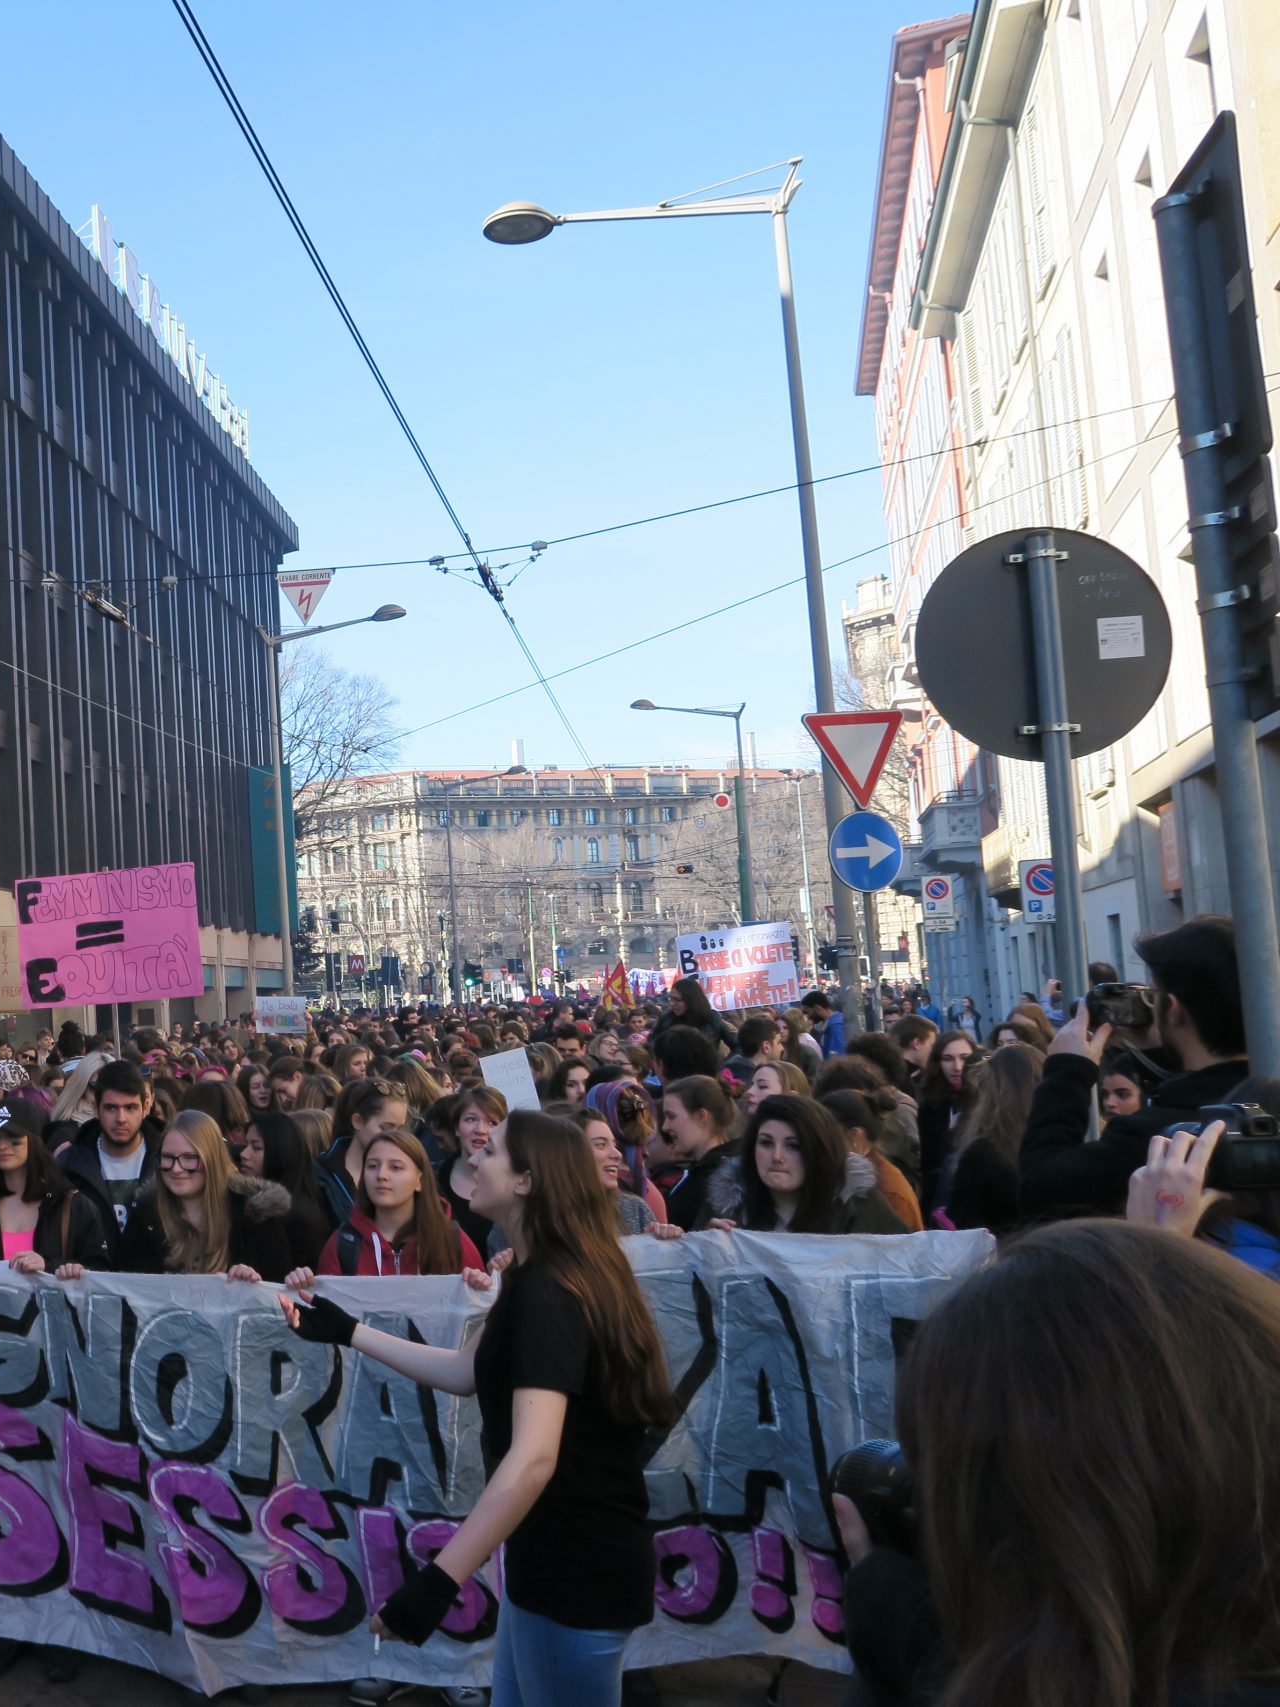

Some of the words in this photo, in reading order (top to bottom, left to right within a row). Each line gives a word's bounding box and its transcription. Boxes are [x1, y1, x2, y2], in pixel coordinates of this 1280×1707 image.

[279, 574, 299, 582] LEVARE
[301, 571, 331, 580] CORRENTE
[17, 865, 198, 925] FEMMINISMO
[679, 948, 731, 974] BARBIE
[744, 941, 795, 965] VOLETE
[1, 985, 23, 998] FREG
